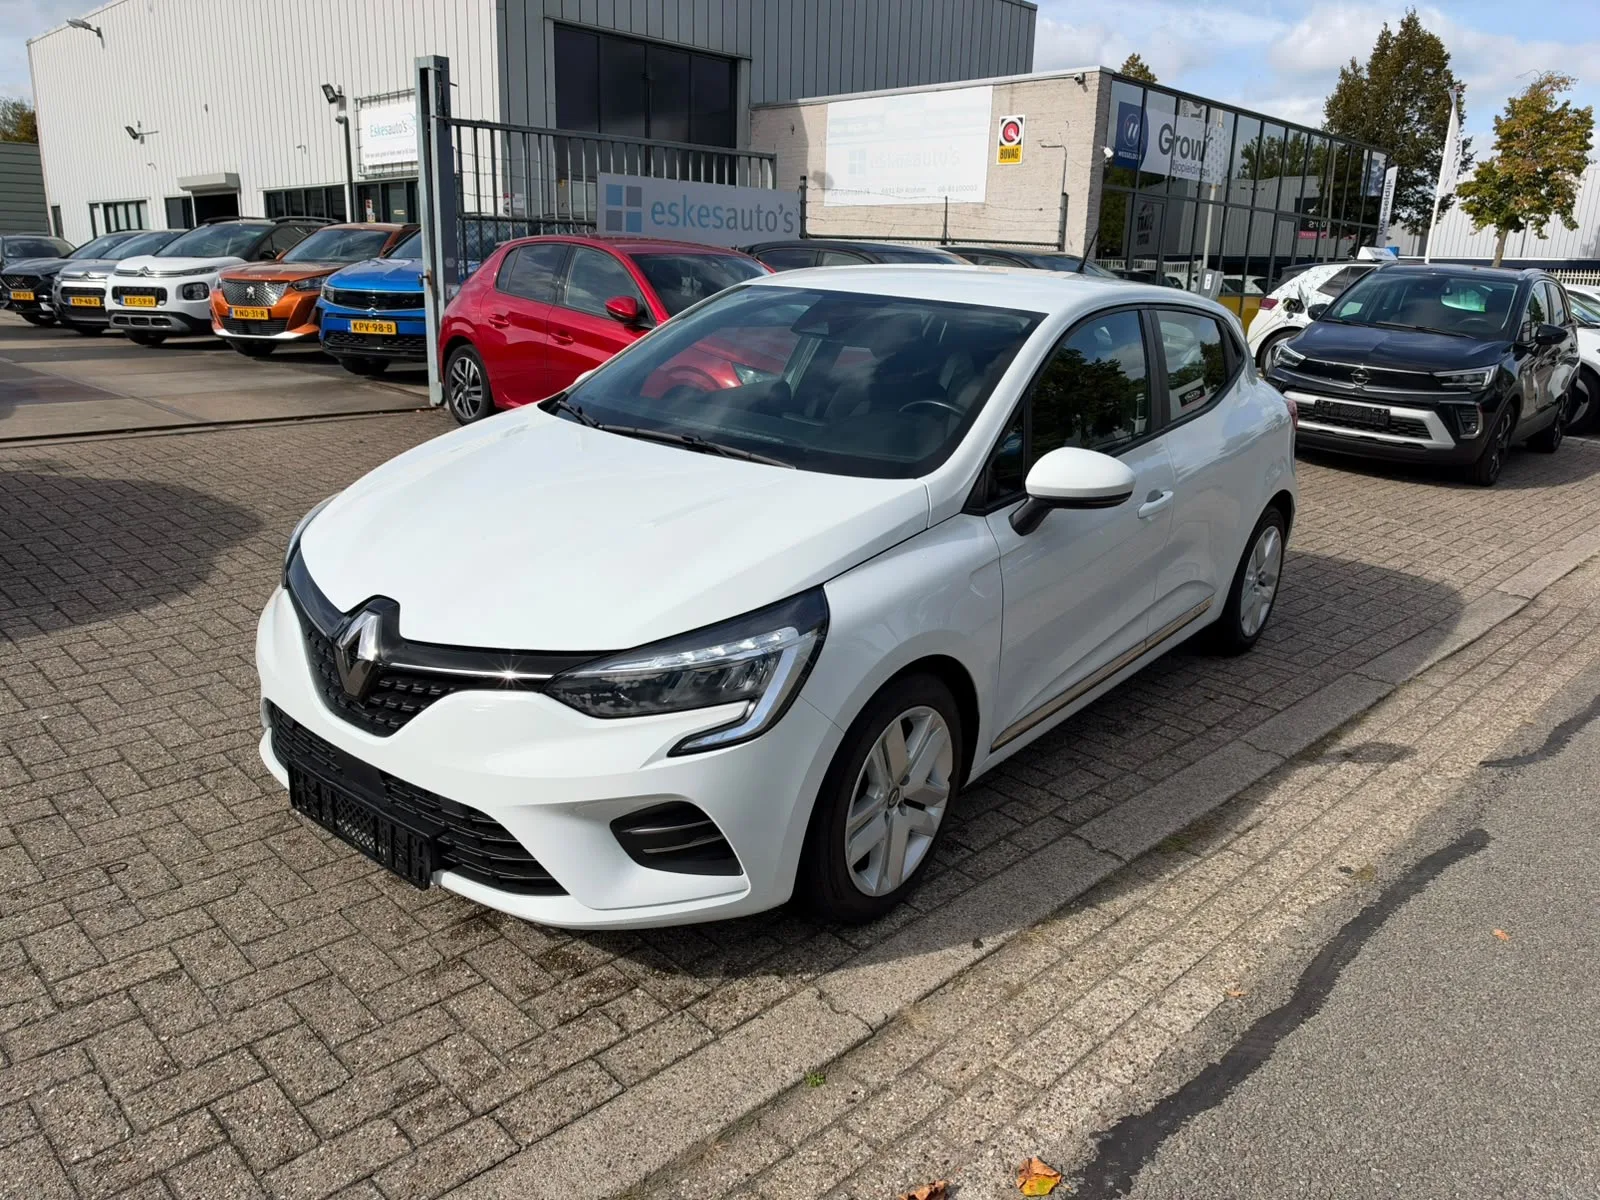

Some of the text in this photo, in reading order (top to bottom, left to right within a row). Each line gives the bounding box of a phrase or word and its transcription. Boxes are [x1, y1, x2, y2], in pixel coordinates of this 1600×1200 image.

[1000, 148, 1019, 160] BOVAG
[650, 194, 795, 234] eskesauto's
[234, 309, 266, 319] KND-31-R
[353, 322, 393, 333] KPV-98-B
